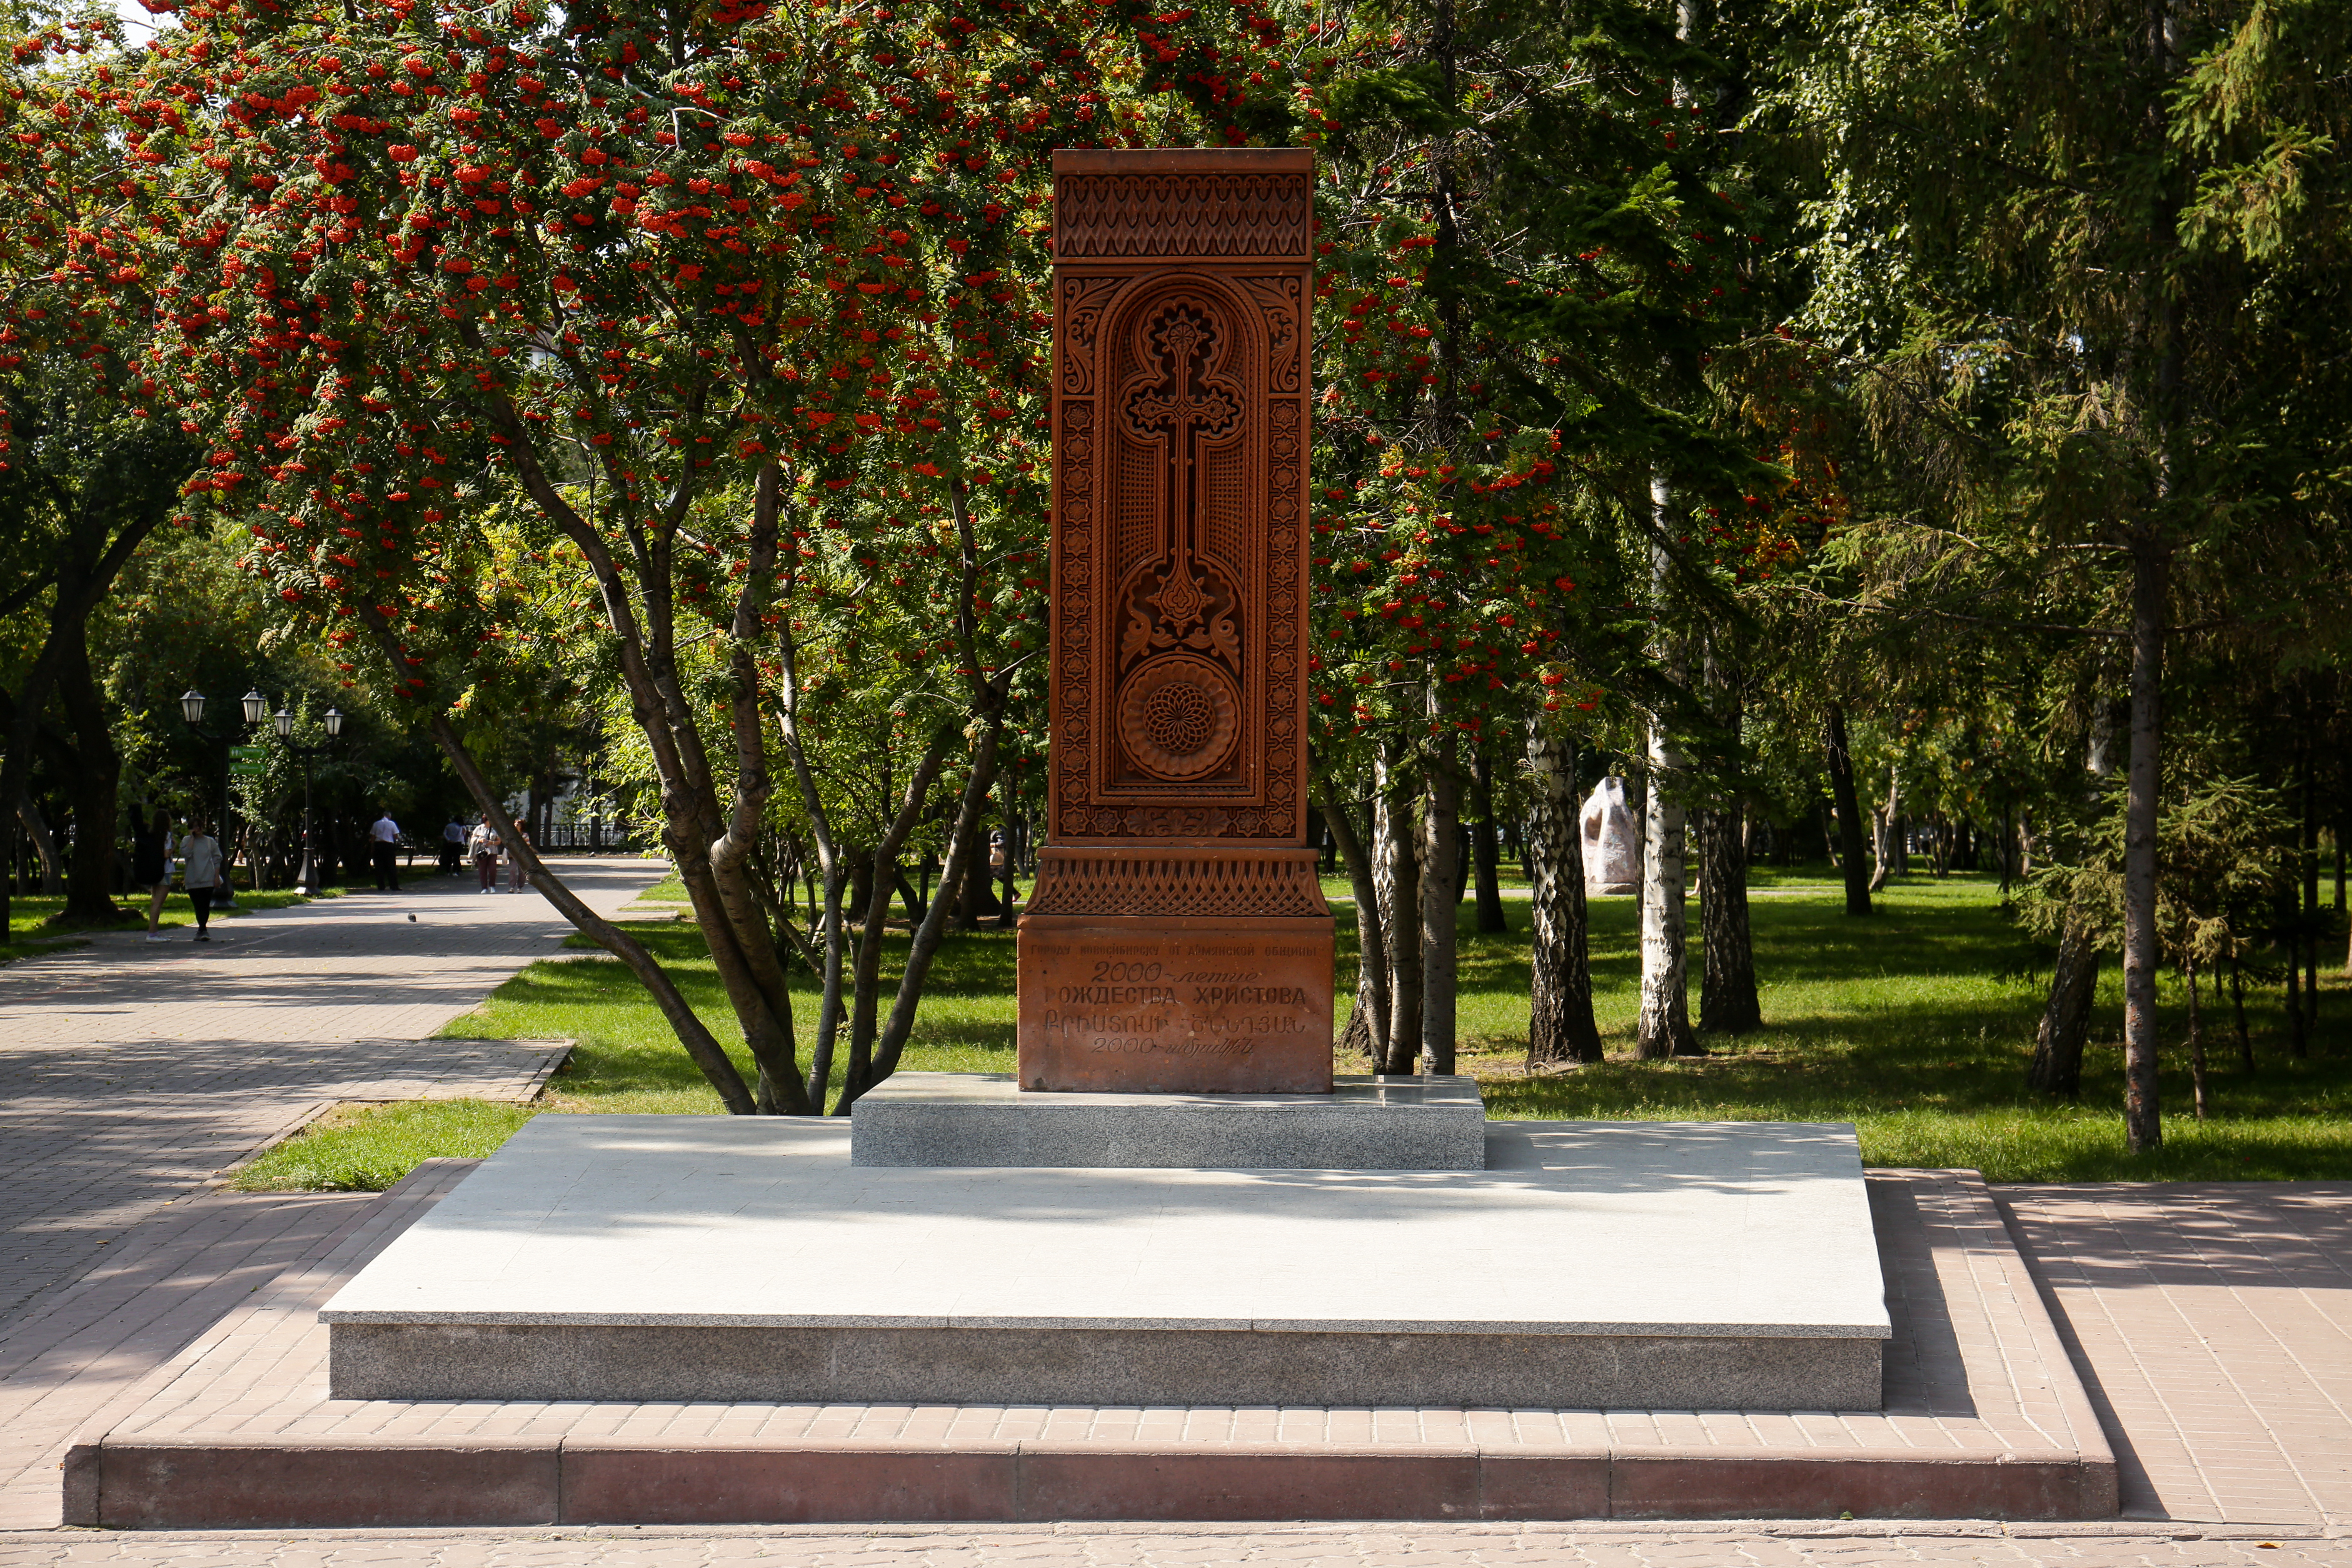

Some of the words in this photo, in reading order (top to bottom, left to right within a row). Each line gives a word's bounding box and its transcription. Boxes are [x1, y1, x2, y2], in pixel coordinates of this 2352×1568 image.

[1030, 945, 1071, 956] ГОРОДУ
[1080, 945, 1160, 957] НОВОСИБИРСКУ
[1168, 945, 1182, 956] ОТ
[1188, 945, 1255, 957] АРМЯНСКОЙ
[1264, 946, 1317, 957] ОБЩИНЫ
[1092, 961, 1259, 983] 2000-летие
[1045, 986, 1179, 1005] РОЖДЕСТВА
[1195, 987, 1307, 1005] ХРИСТОВА
